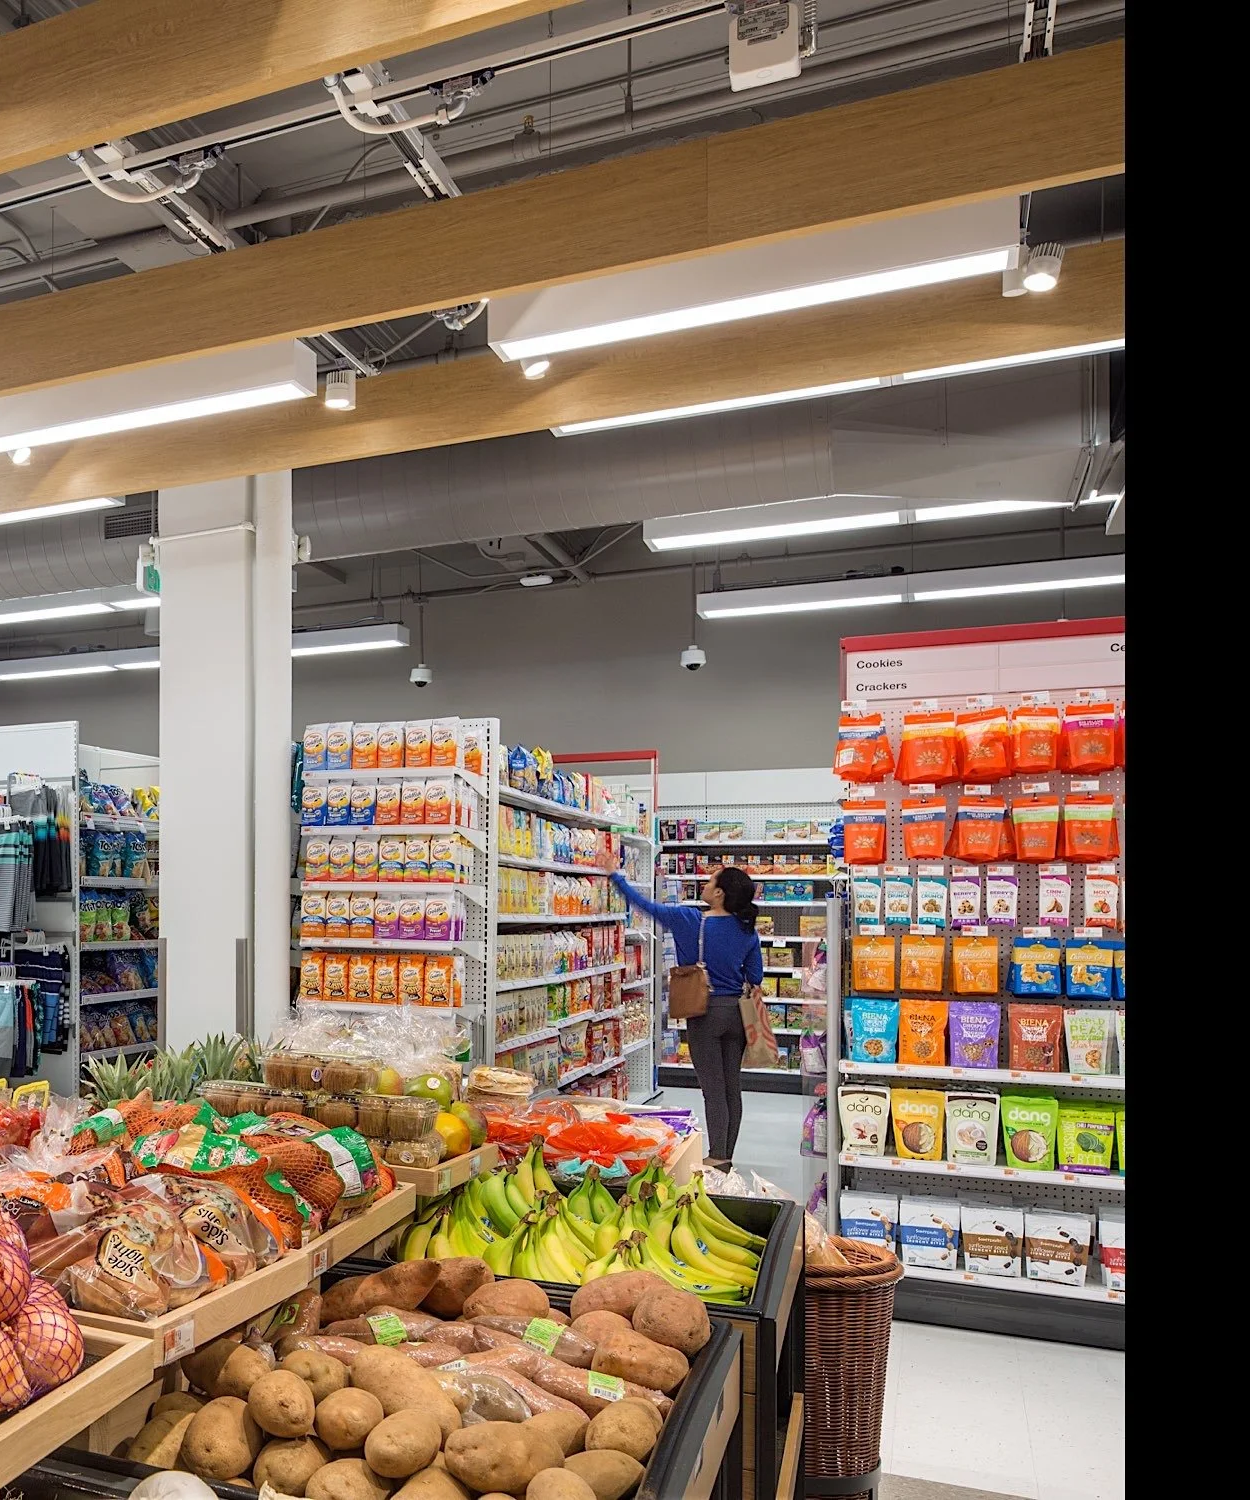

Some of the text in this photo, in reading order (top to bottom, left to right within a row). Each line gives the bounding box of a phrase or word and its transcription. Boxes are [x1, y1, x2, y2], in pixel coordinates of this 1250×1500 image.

[856, 657, 903, 670] Cookies
[856, 680, 907, 692] Crackers
[862, 1012, 888, 1020] BIENA
[1021, 1018, 1048, 1026] BIENA
[847, 1102, 882, 1115] dang
[898, 1101, 938, 1117] dang
[952, 1107, 991, 1121] dang
[1008, 1107, 1050, 1126] dang
[201, 1222, 229, 1246] Side
[108, 1254, 138, 1278] Side
